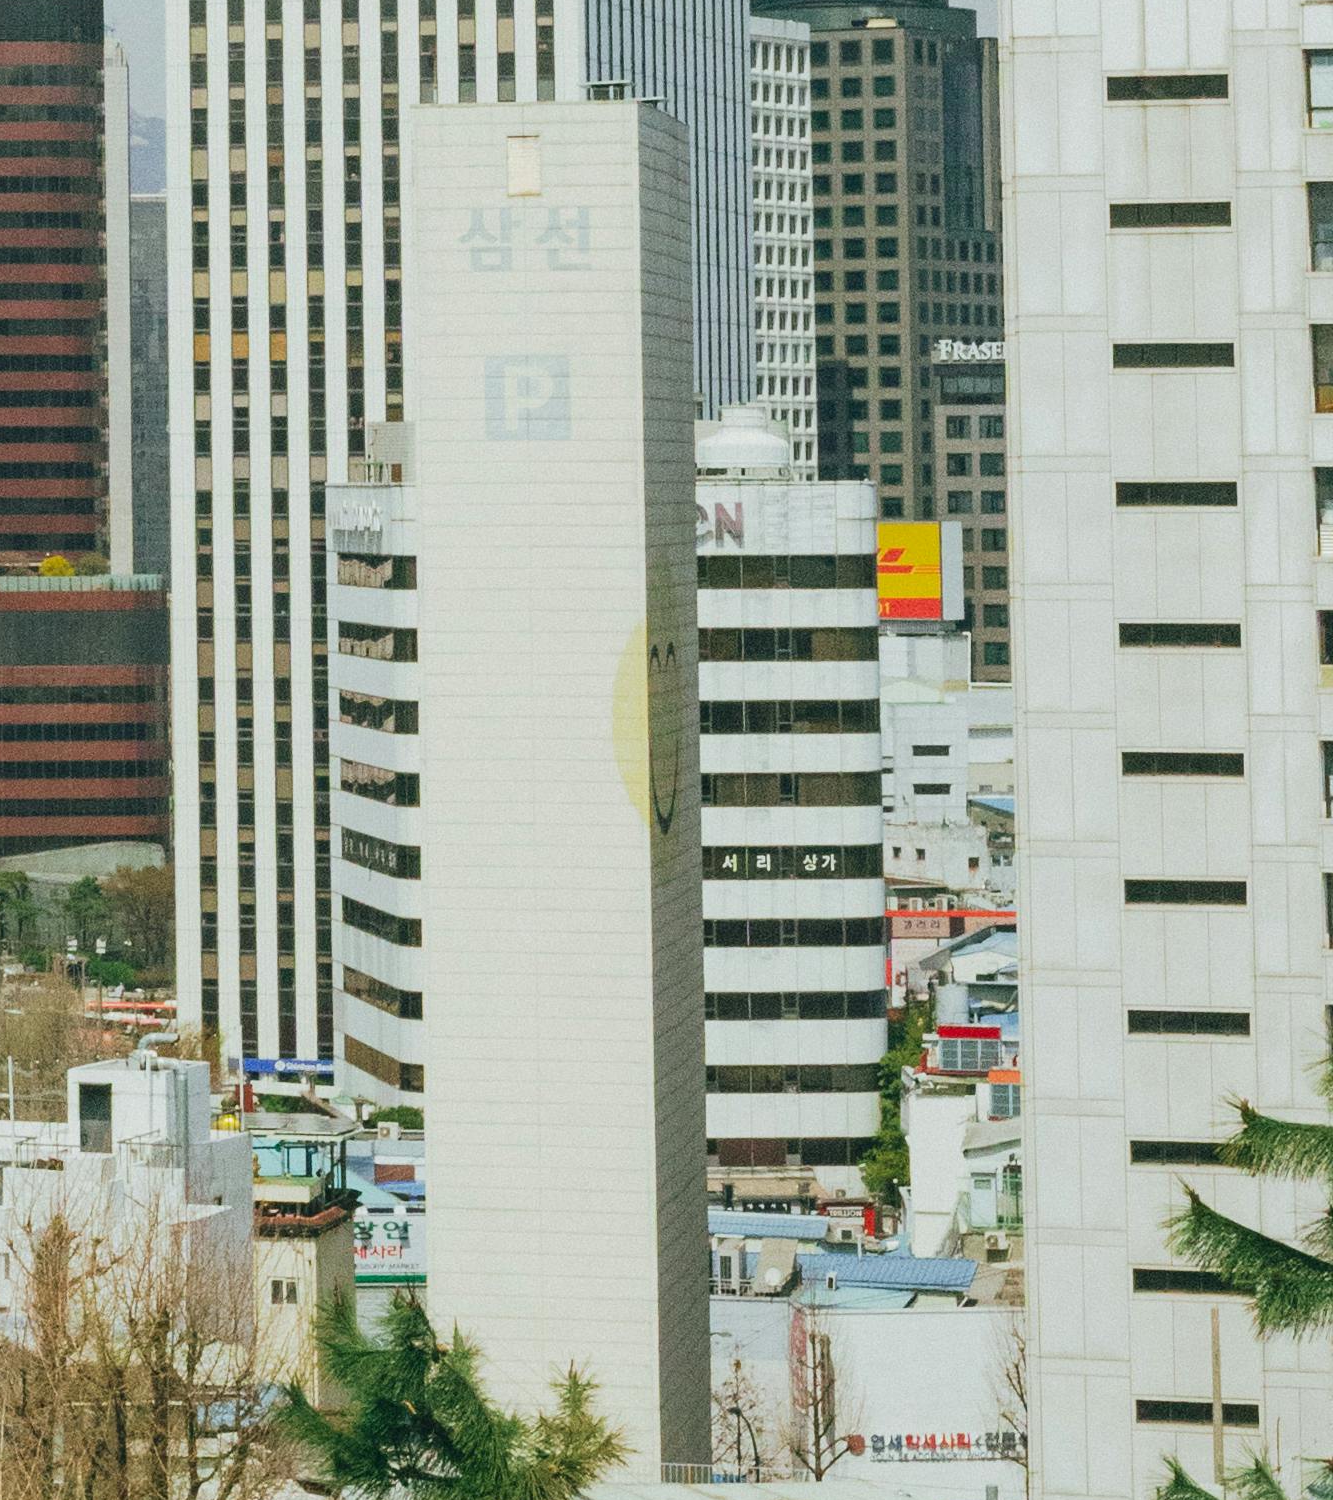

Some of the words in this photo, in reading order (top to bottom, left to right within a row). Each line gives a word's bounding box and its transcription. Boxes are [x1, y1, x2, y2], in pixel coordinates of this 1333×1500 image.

[937, 338, 1006, 362] FRASE
[503, 364, 554, 433] P
[802, 853, 837, 872] 상가
